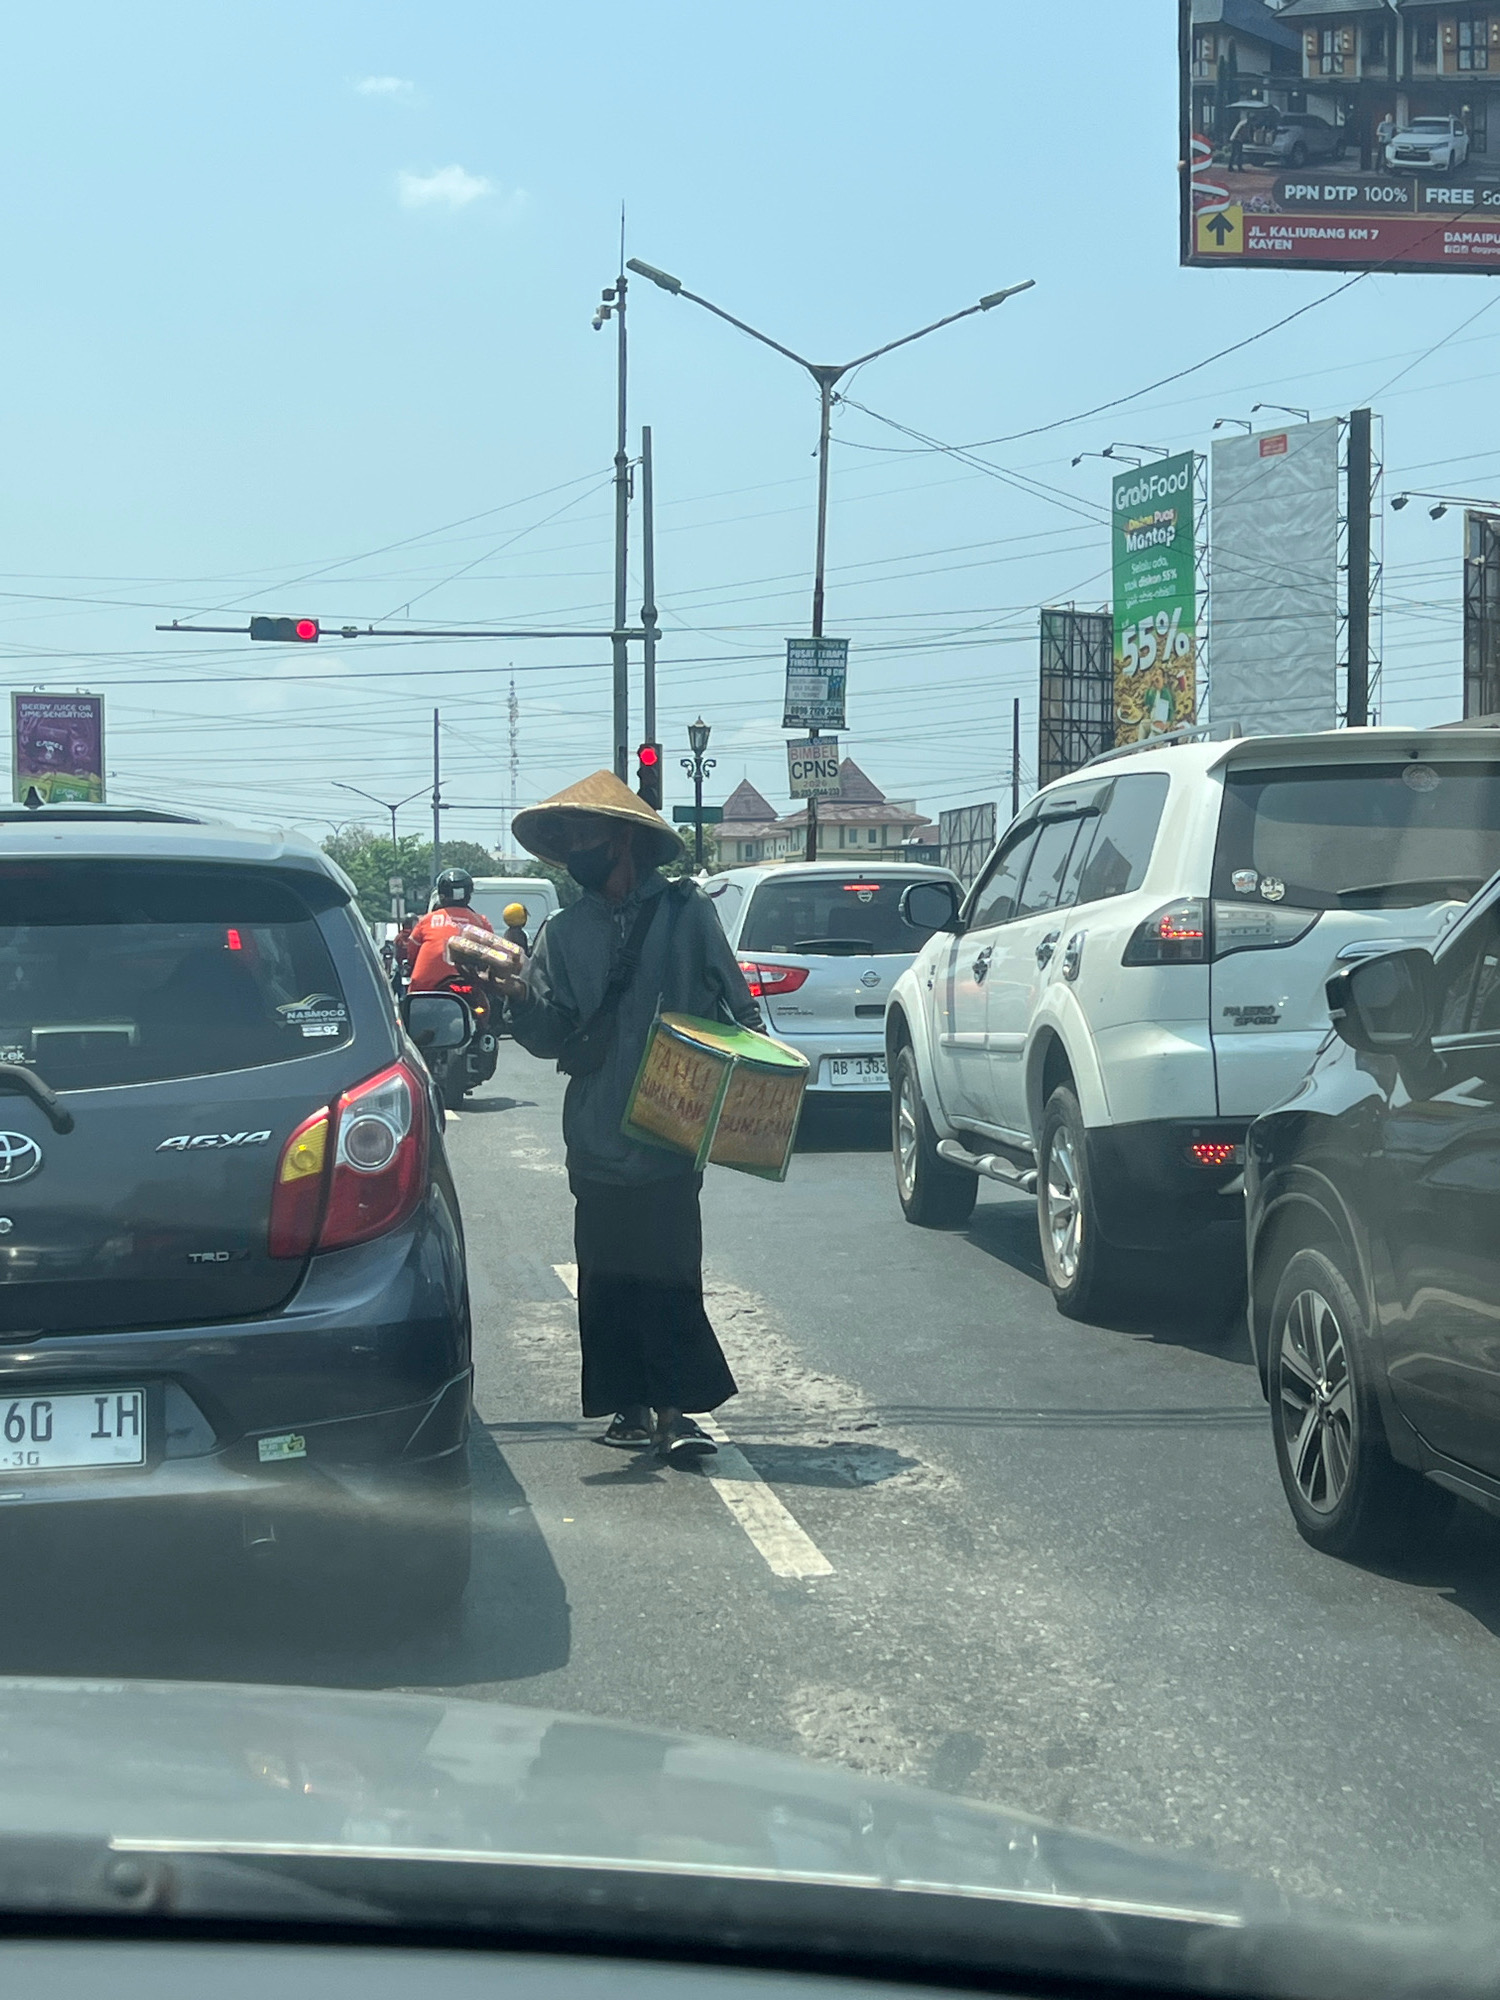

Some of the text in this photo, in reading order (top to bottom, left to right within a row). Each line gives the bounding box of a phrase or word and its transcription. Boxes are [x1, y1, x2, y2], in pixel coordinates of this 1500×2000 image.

[1284, 185, 1408, 203] PPN DTP 100%
[1426, 188, 1475, 204] FREE
[1269, 226, 1346, 240] KALIURANG
[1348, 229, 1368, 240] KM
[1370, 230, 1379, 240] 7
[1248, 238, 1293, 250] KAYEN
[1115, 463, 1188, 511] GrabFood
[1125, 525, 1176, 554] Mantap
[1121, 607, 1190, 677] 55%
[21, 703, 52, 711] BERRY
[53, 704, 77, 712] JUICE
[42, 711, 94, 719] SENSATION
[35, 740, 64, 751] CAMEL
[790, 745, 838, 761] BIMBEL
[791, 759, 838, 780] CPNS
[286, 1009, 346, 1019] NASMOCO
[1223, 1005, 1276, 1017] PAJERO
[1233, 1015, 1282, 1027] SPORT
[323, 1025, 338, 1035] 92
[832, 1061, 849, 1076] AB
[155, 1130, 272, 1152] AGYA
[188, 1251, 230, 1263] TRD
[90, 1395, 139, 1440] IH
